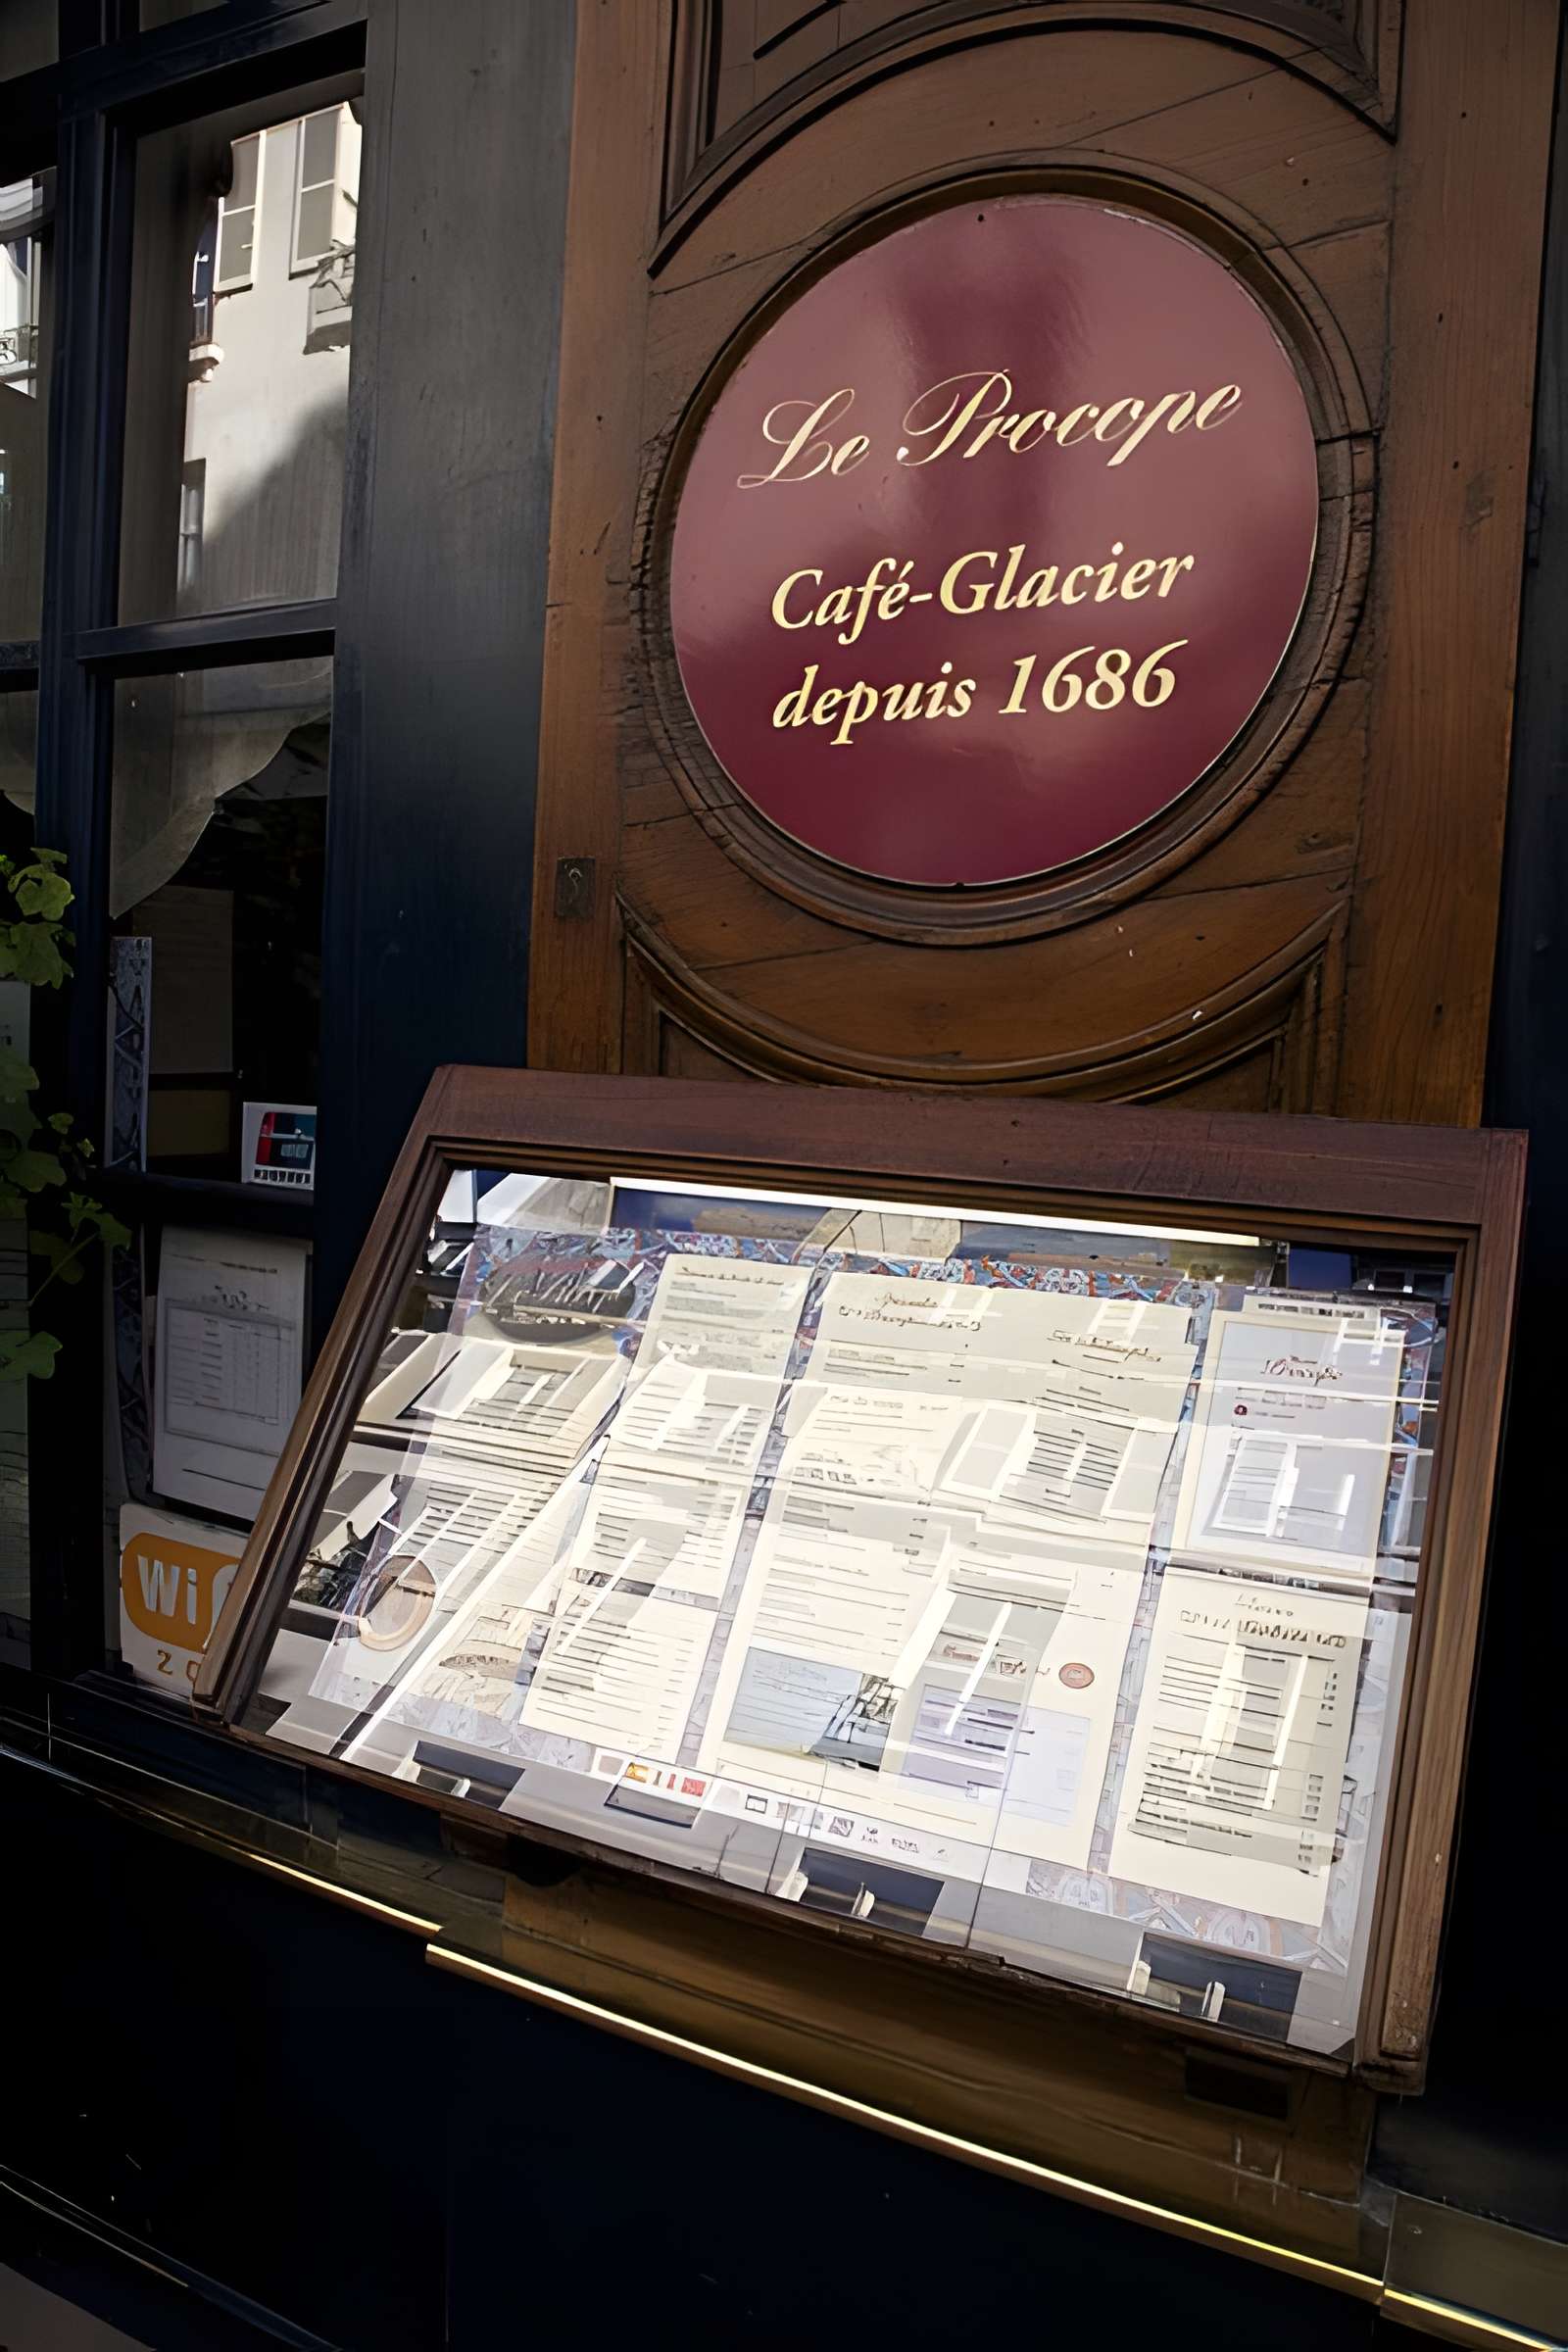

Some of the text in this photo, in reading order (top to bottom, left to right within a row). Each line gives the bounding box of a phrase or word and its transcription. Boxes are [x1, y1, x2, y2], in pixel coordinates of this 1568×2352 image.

[737, 368, 1243, 489] Le Procope
[771, 541, 1195, 646] Café-Glacier
[771, 639, 1189, 747] depuis 1686
